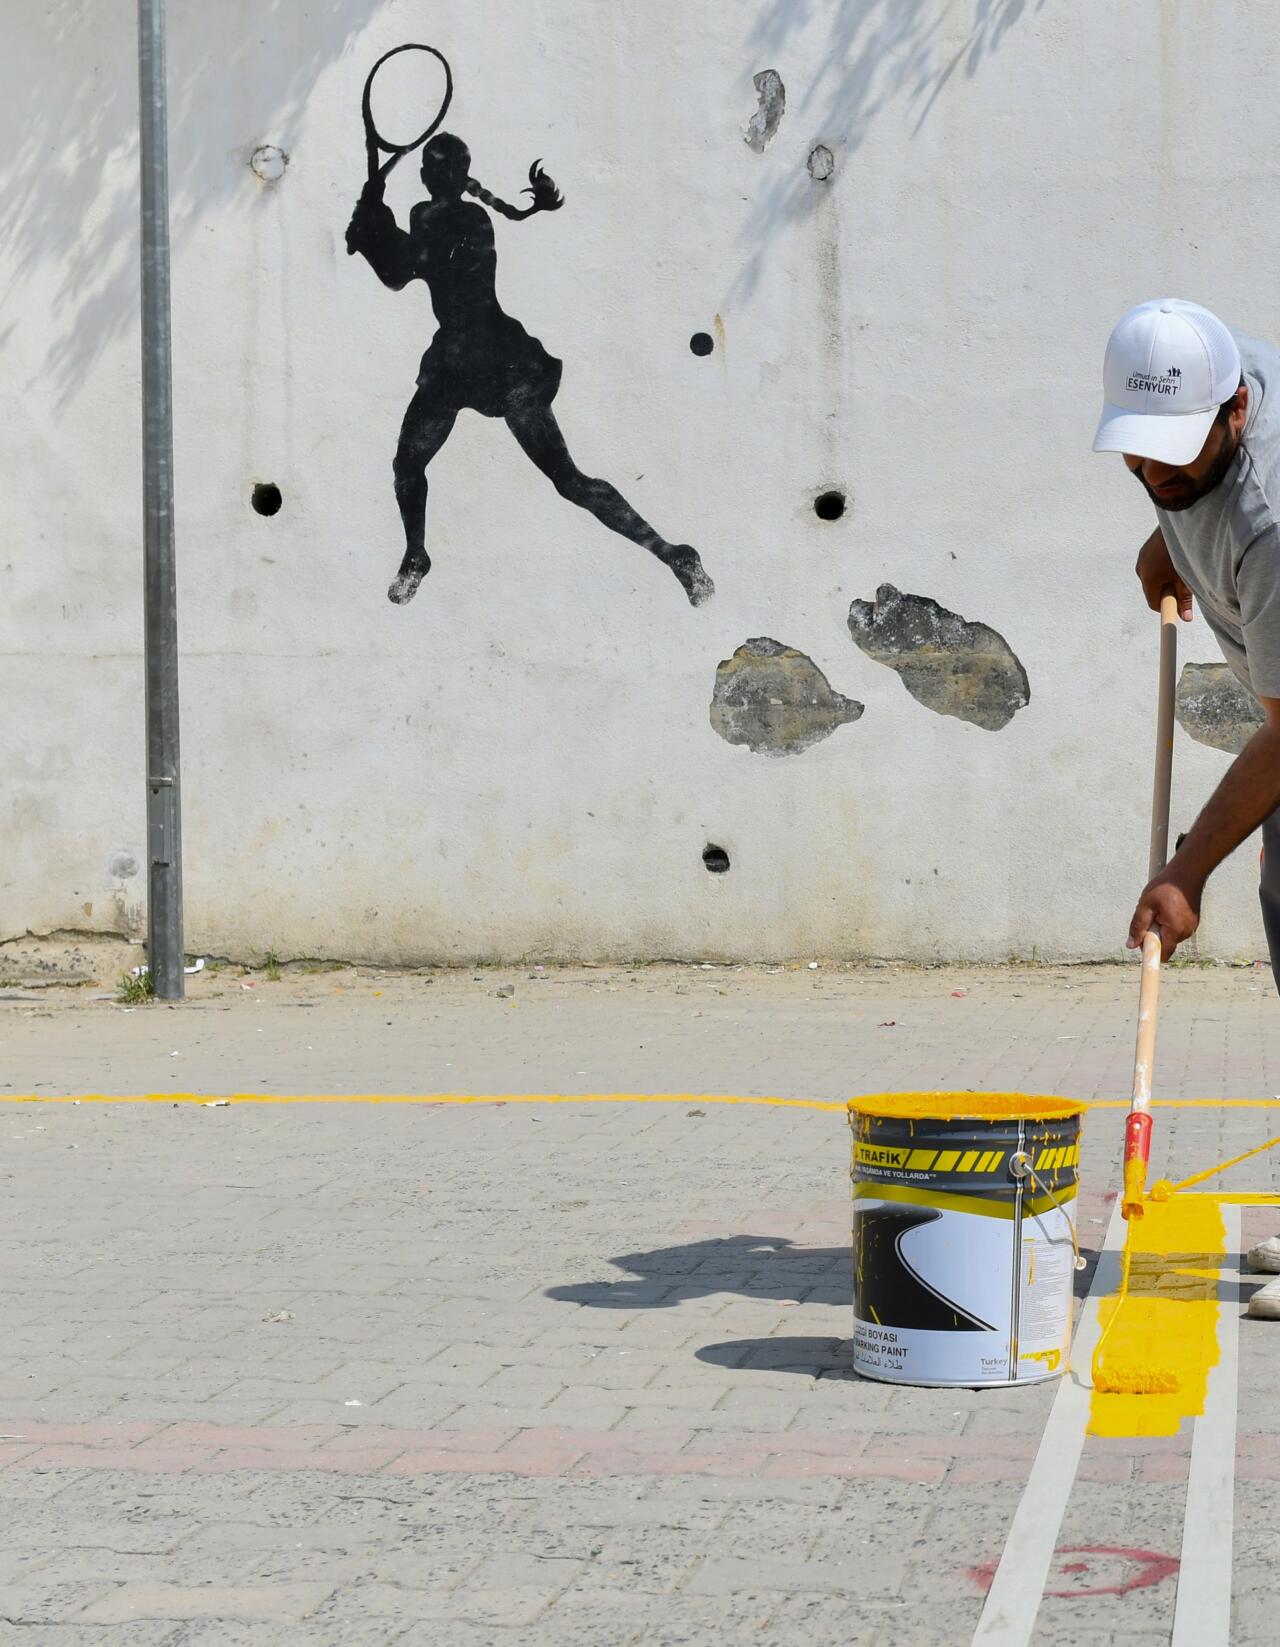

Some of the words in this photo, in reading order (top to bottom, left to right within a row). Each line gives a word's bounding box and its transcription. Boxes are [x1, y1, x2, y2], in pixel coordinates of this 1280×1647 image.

[1128, 377, 1179, 395] ESENYURT
[860, 1149, 901, 1165] TRAFİK
[883, 1169, 891, 1178] VE
[892, 1171, 930, 1181] YOLLARDA
[868, 1329, 898, 1343] BOYASI
[881, 1345, 909, 1358] PAINT
[980, 1358, 1008, 1367] Turkey
